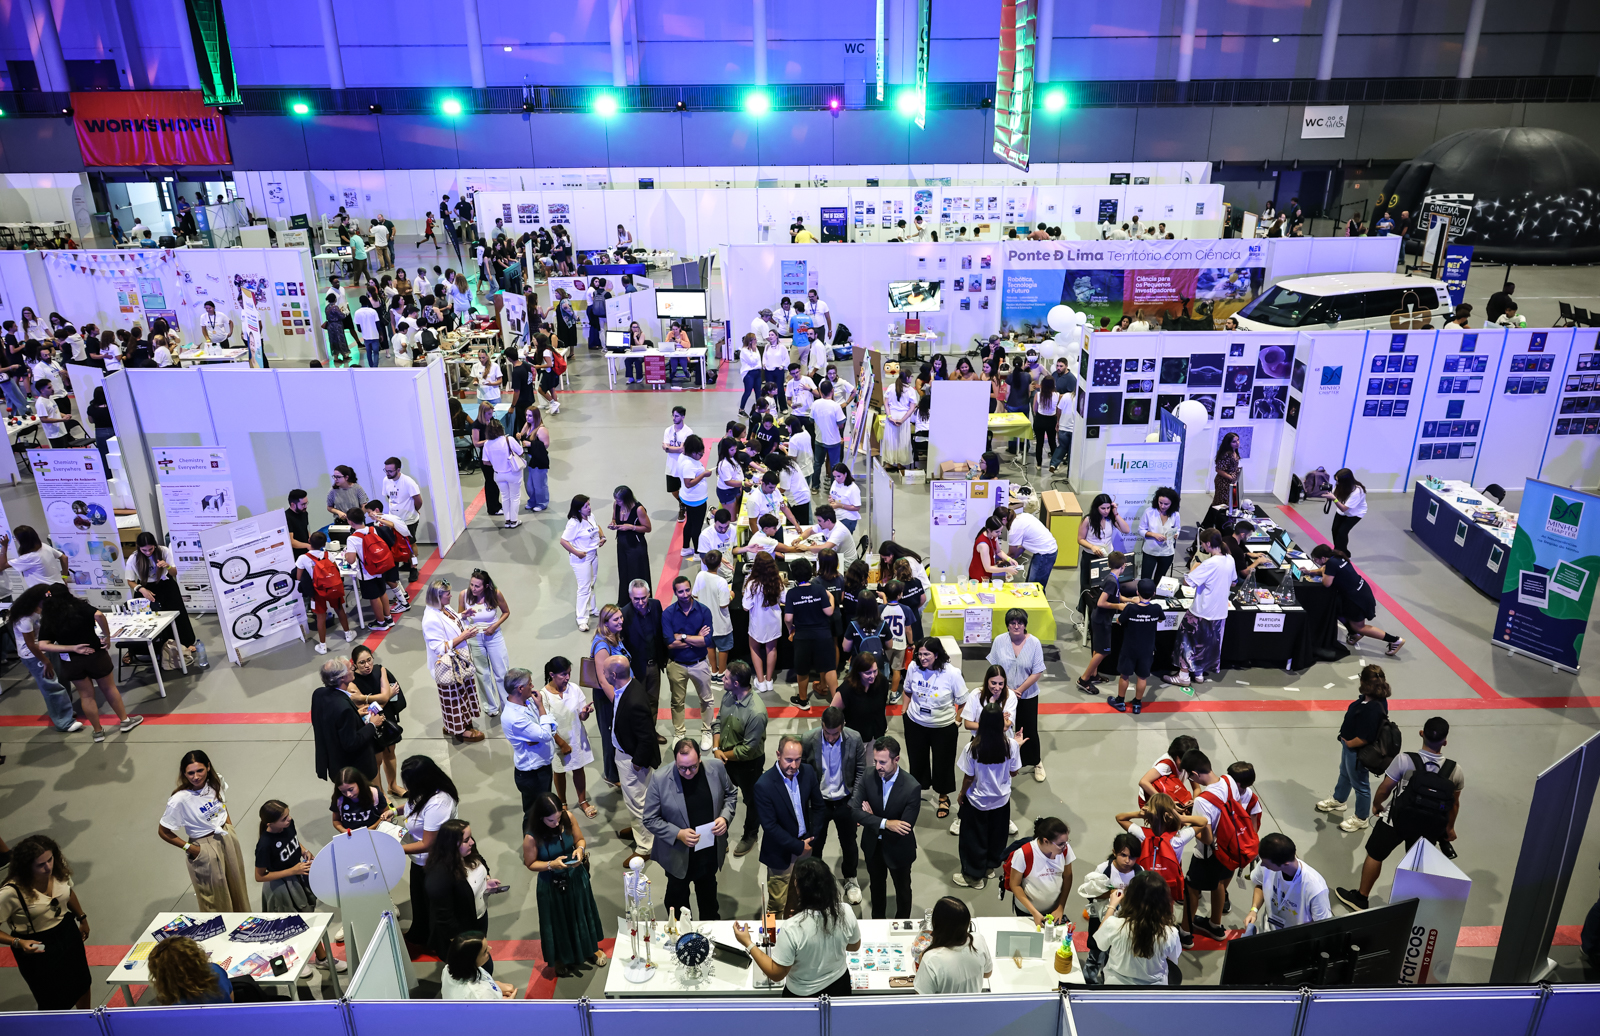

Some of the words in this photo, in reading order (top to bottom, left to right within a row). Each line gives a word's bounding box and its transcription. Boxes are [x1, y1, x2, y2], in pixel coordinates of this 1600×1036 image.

[844, 43, 865, 54] WC
[84, 118, 216, 133] WORKSHOPS
[1305, 118, 1324, 127] WC
[1009, 250, 1050, 261] Ponte
[1067, 249, 1104, 261] Lima
[1107, 250, 1161, 261] Território
[1164, 253, 1192, 261] com
[1195, 248, 1241, 260] Ciência
[757, 432, 772, 441] CLV
[1546, 526, 1576, 538] CHAPTER
[1548, 520, 1578, 533] MINHO
[884, 615, 903, 637] 75
[343, 810, 371, 822] CLV
[279, 837, 299, 862] CLV
[1426, 931, 1437, 955] YEARS
[1424, 957, 1430, 965] 10
